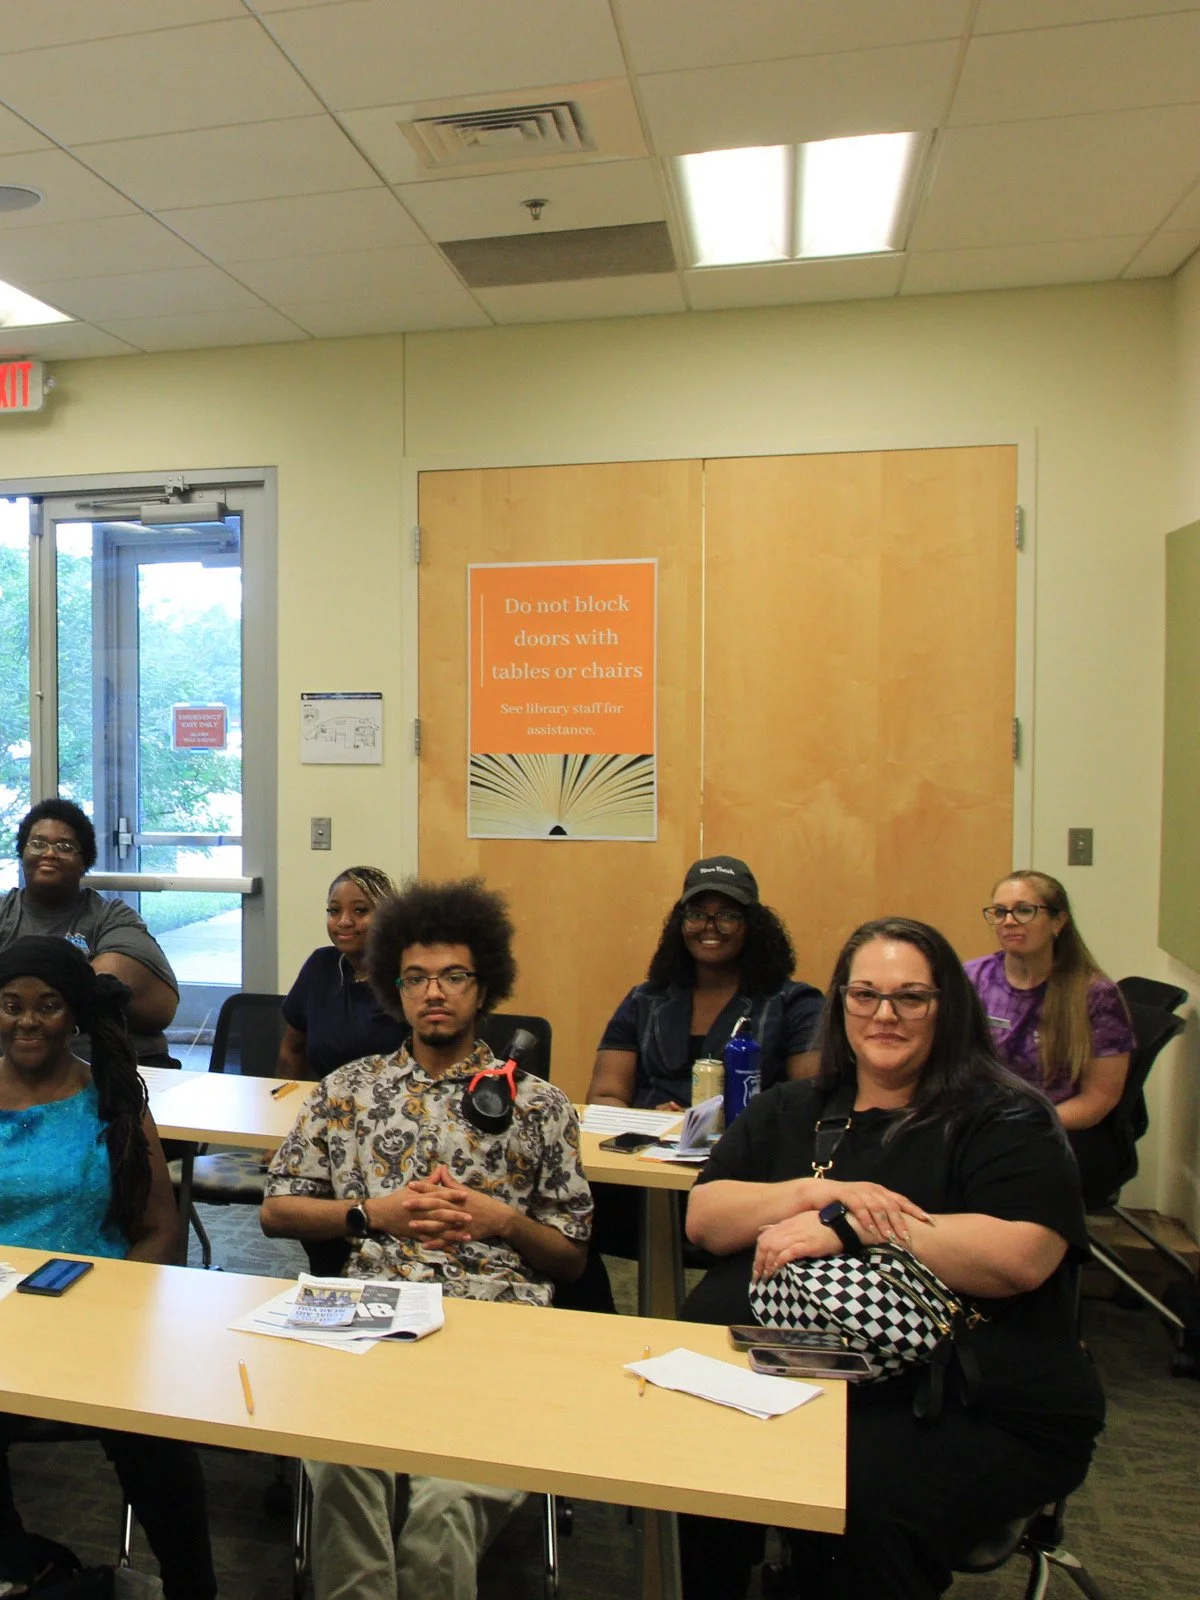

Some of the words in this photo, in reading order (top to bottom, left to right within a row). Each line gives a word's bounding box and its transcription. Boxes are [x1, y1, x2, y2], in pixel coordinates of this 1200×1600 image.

[505, 598, 532, 614] Do
[536, 600, 570, 614] not
[574, 594, 630, 613] block
[514, 629, 570, 647] doors
[575, 627, 619, 646] with
[492, 662, 551, 680] tables
[555, 666, 577, 679] or
[581, 661, 643, 679] chairs
[500, 703, 523, 714] See
[526, 703, 569, 716] library
[572, 702, 602, 714] staff
[604, 702, 624, 714] for
[527, 724, 595, 735] assistance.
